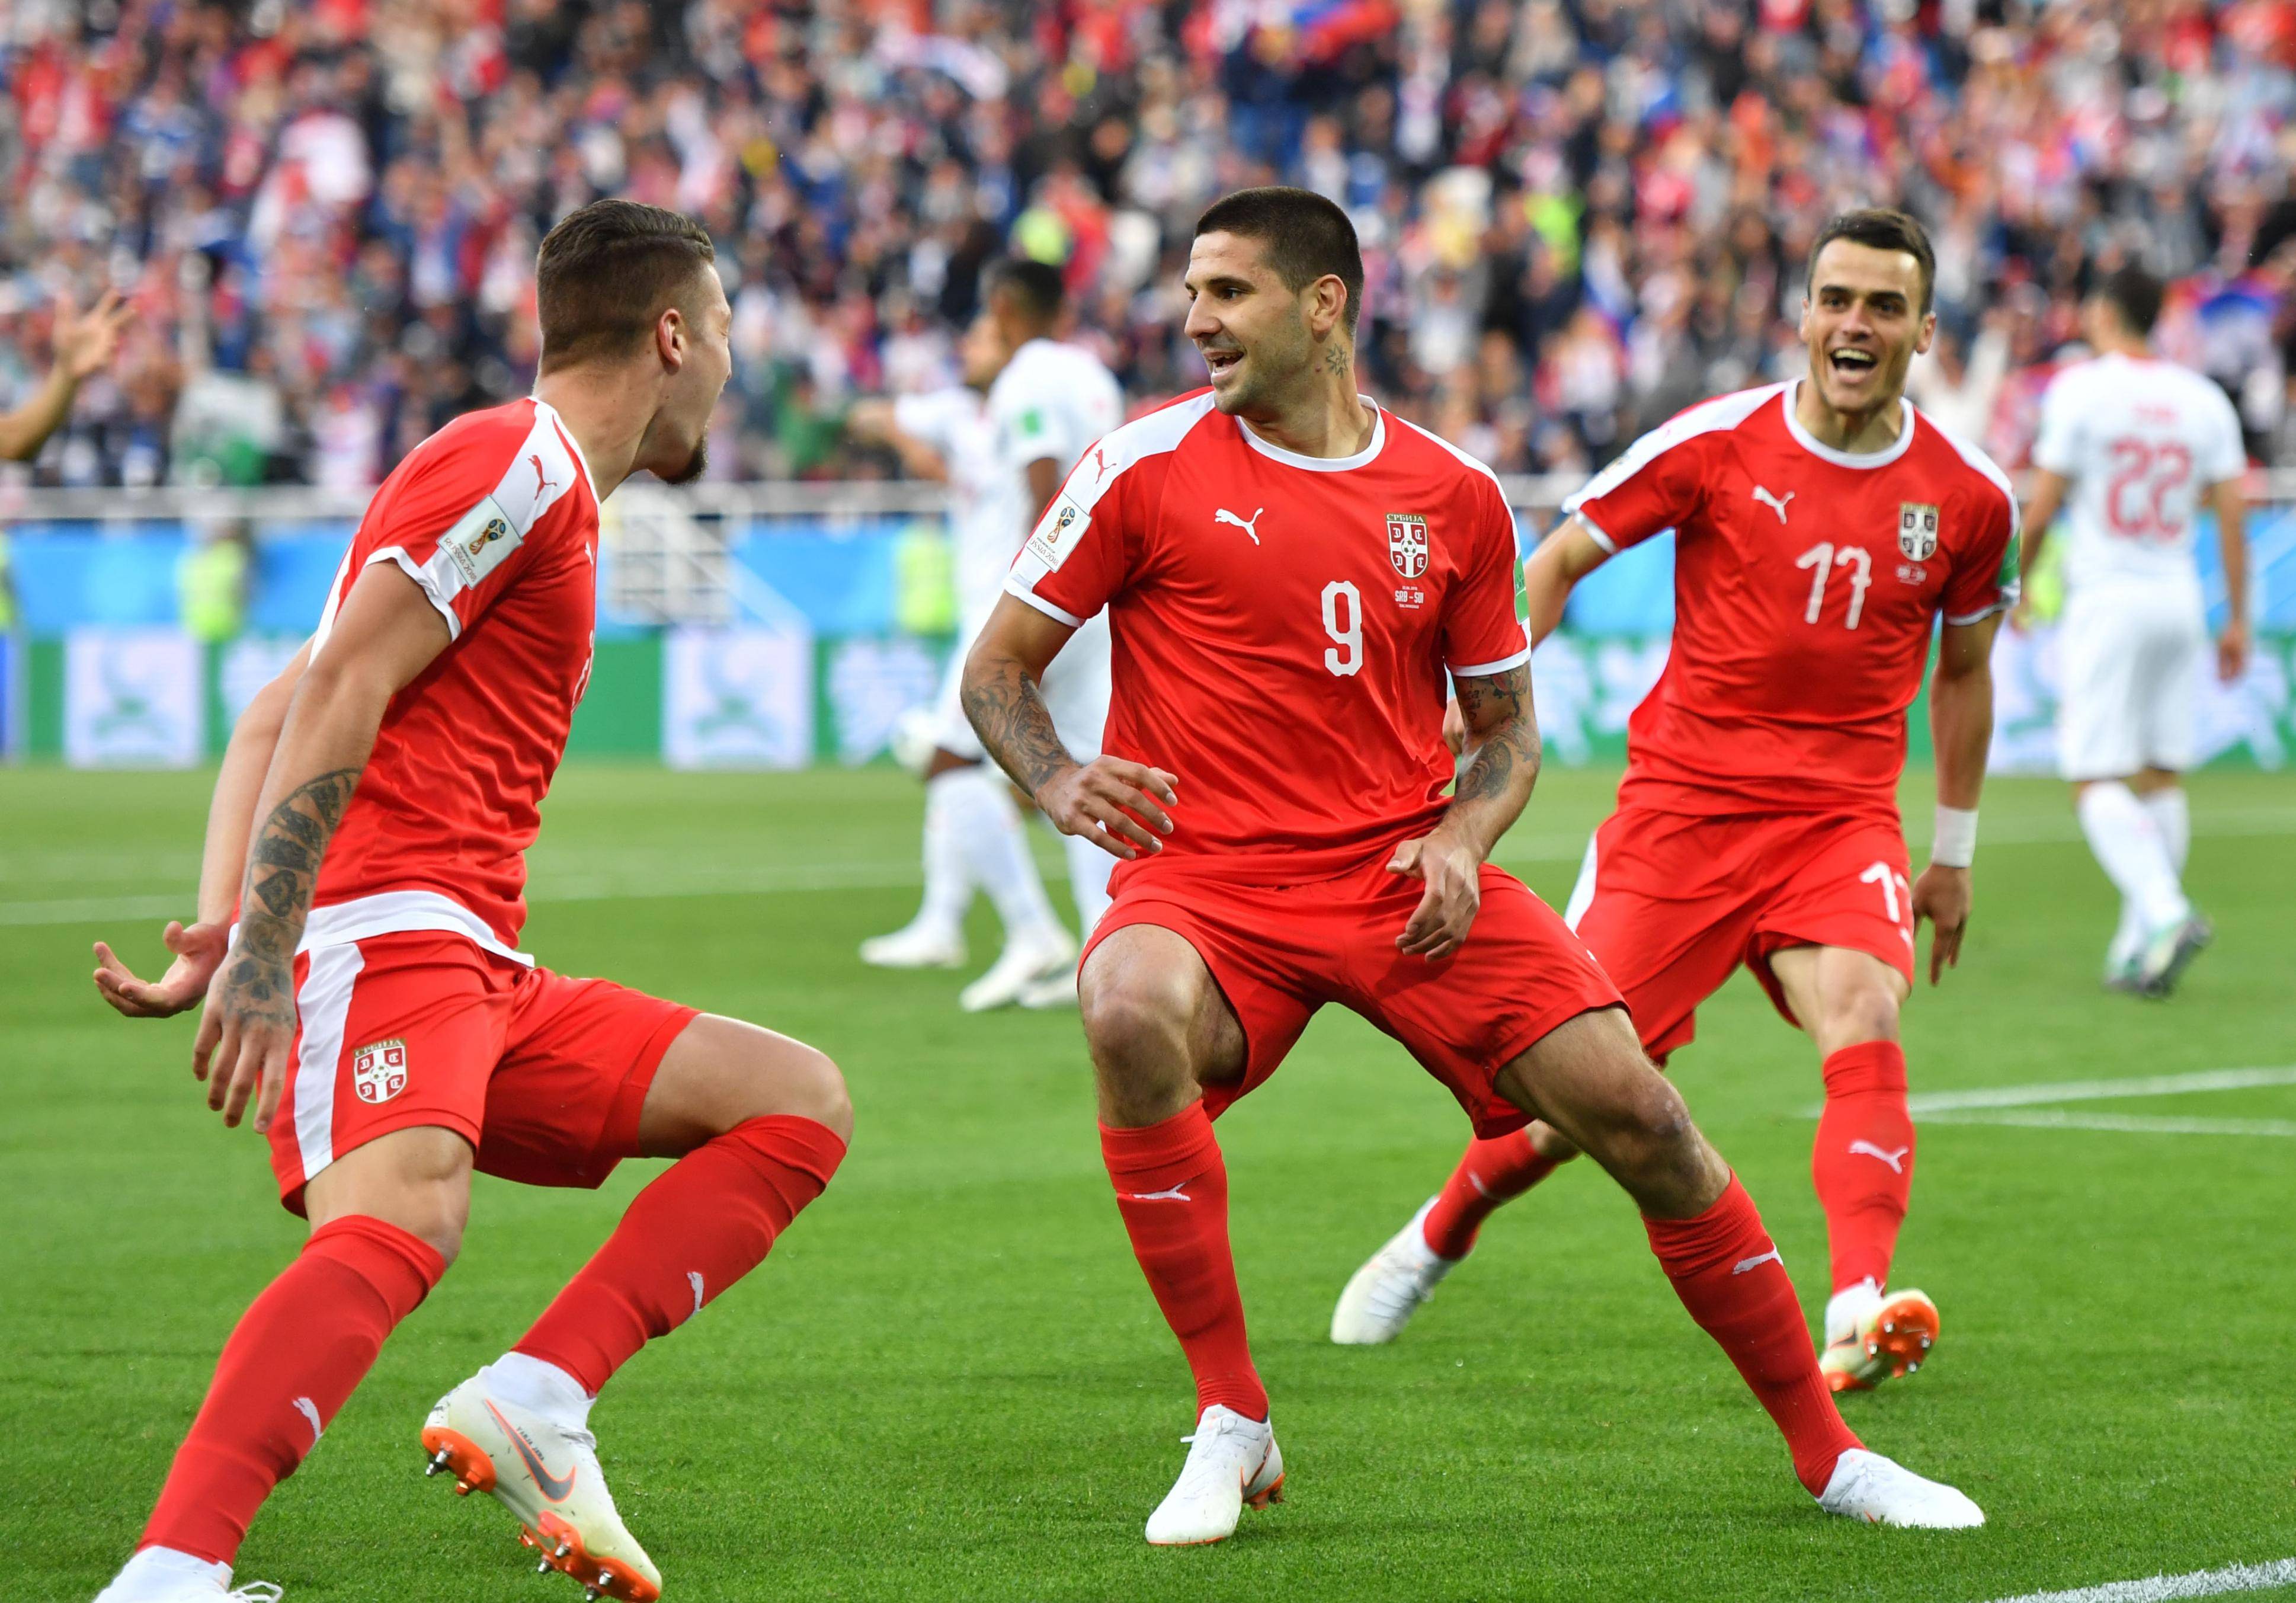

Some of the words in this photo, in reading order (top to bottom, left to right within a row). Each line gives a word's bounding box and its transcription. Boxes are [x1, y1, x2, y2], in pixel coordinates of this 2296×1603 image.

[2105, 436, 2192, 544] 22
[1386, 514, 1424, 523] СРБИЈА
[444, 537, 466, 565] RUSSIA
[1029, 538, 1046, 555] USSIA
[1045, 552, 1059, 566] 2018
[1395, 590, 1408, 603] SRB
[1414, 591, 1424, 604] SUI
[1795, 542, 1872, 631] 17
[1321, 580, 1363, 677] 9
